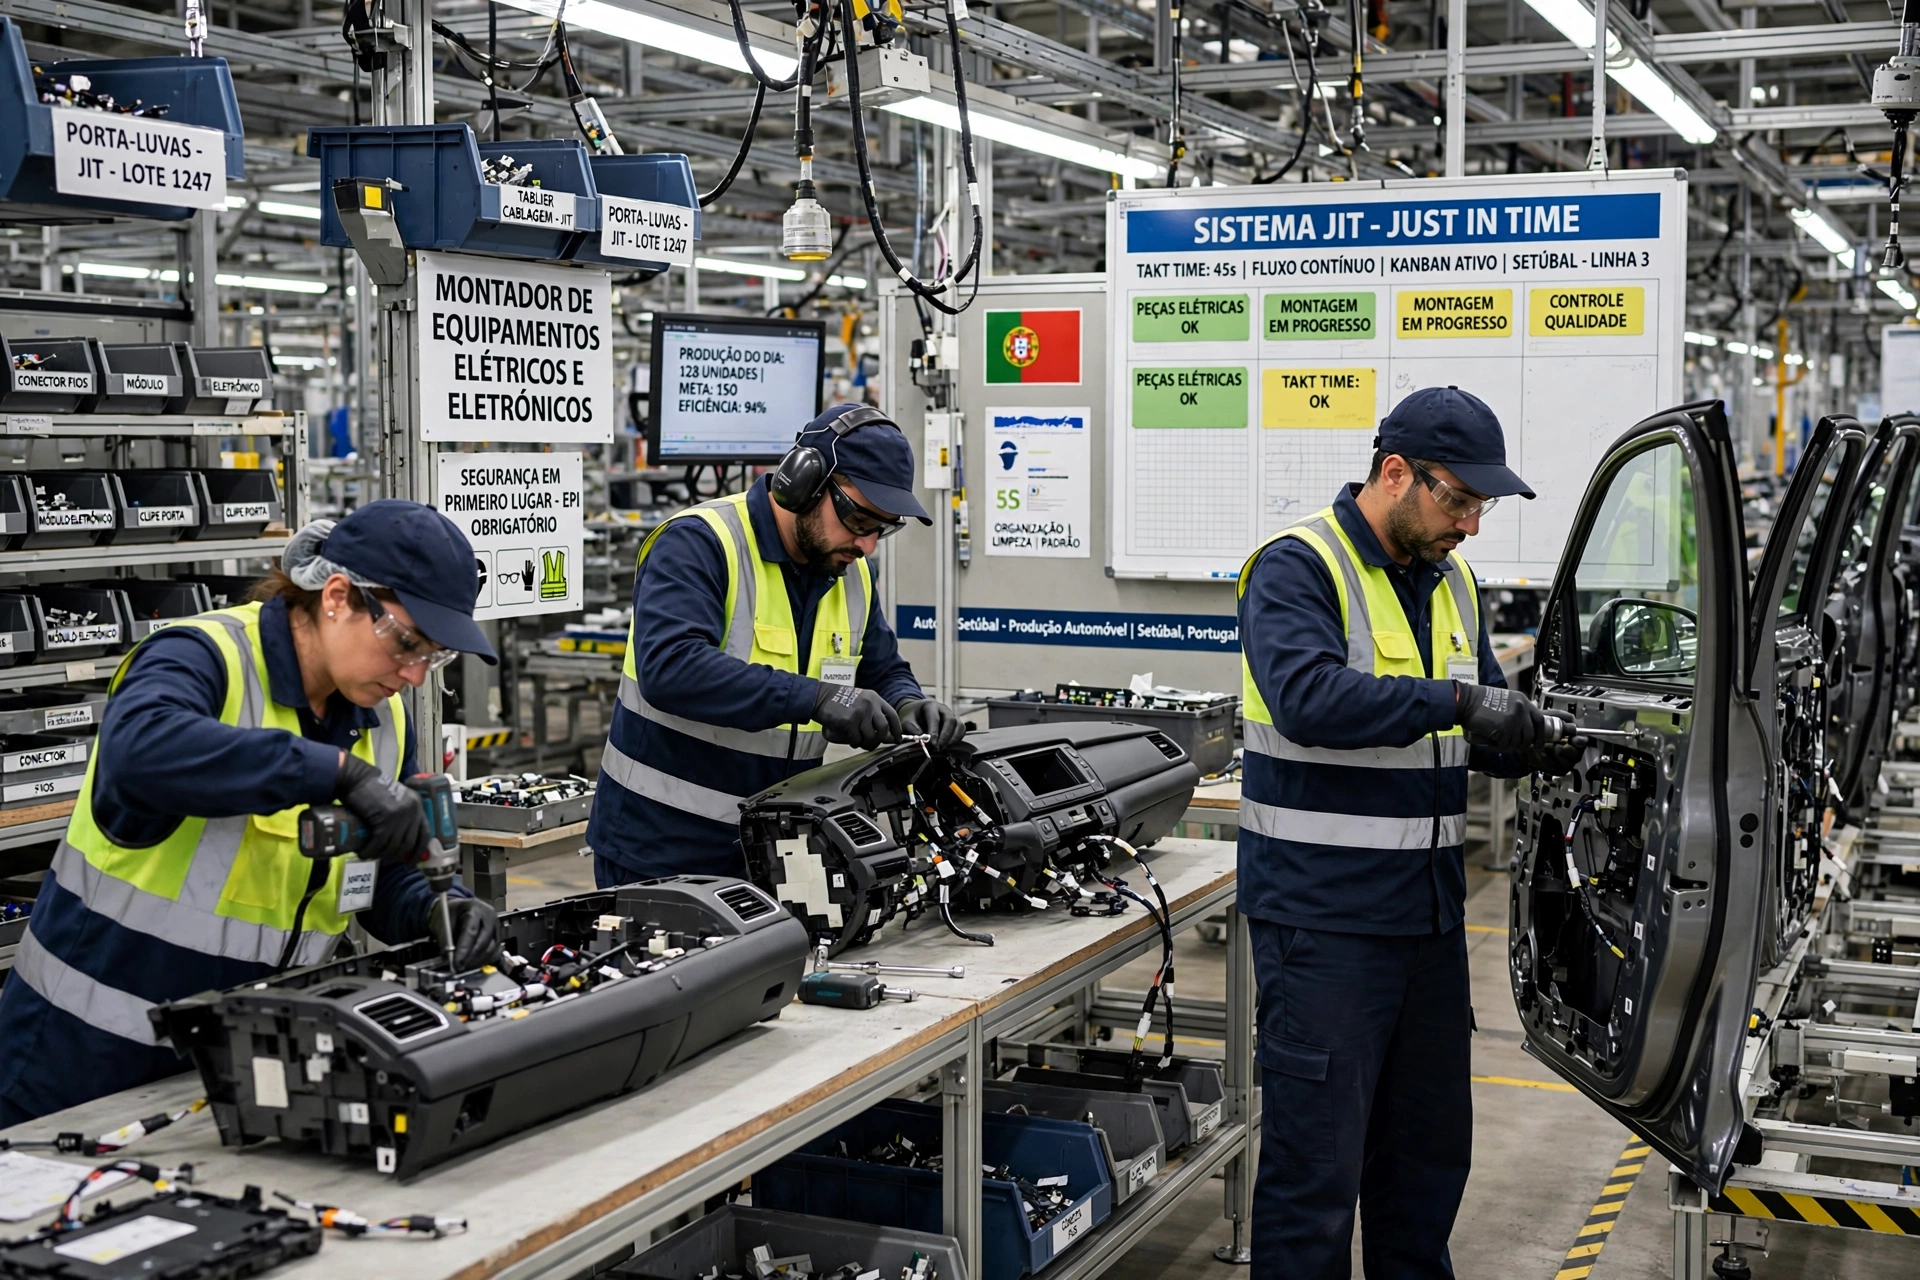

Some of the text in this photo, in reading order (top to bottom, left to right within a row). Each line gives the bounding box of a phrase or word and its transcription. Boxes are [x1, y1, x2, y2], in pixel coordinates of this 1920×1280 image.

[67, 122, 191, 158] PORTA-LUVAS
[78, 157, 104, 179] JIT
[123, 162, 166, 187] LOTE
[172, 169, 212, 191] 1247
[518, 190, 554, 208] TABLIER
[503, 205, 553, 223] CABLAGEM
[561, 214, 573, 226] JIT
[609, 206, 681, 231] PORTA-LUVAS
[1194, 212, 1317, 244] SISTEMA
[1322, 211, 1364, 240] JIT
[1386, 209, 1459, 239] JUST
[1467, 207, 1498, 236] IN
[1504, 205, 1580, 235] TIME
[611, 230, 626, 246] JIT
[636, 233, 660, 250] LOTE
[663, 237, 687, 254] 1247
[1136, 263, 1170, 279] TAKT
[1173, 262, 1210, 278] TIME:
[1213, 262, 1237, 277] 45s
[1252, 260, 1297, 276] FLUXO
[1300, 255, 1376, 275] CONTÍNUO
[1391, 256, 1451, 272] KANBAN
[1454, 255, 1498, 271] ATIVO
[1512, 250, 1578, 270] SETÚBAL
[1591, 251, 1637, 268] LINHA
[1641, 251, 1650, 267] 3
[436, 273, 593, 314] MONTADOR DE
[1549, 293, 1624, 309] CONTROLE
[1137, 298, 1244, 319] PEÇAS ELÉTRICAS
[1280, 298, 1358, 314] MONTAGEM
[1414, 296, 1494, 312] MONTAGEM
[1181, 320, 1199, 334] OK
[1269, 317, 1371, 333] EM PROGRESSO
[1402, 315, 1508, 331] EM PROGRESSO
[1544, 313, 1628, 331] QUALIDADE
[433, 312, 600, 351] EQUIPAMENTOS
[679, 346, 785, 364] PRODUÇÃO DO DIA:
[455, 349, 584, 386] ELÉTRICOS E
[702, 365, 758, 380] UNIDADES
[18, 374, 89, 389] CONECTOR FIOS
[126, 374, 164, 390] MÓDULO
[678, 382, 738, 396] META: 150
[1137, 370, 1242, 390] PEÇAS ELÉTRICAS
[1281, 374, 1360, 389] TAKT TIME:
[448, 388, 593, 423] ELETRÓNICOS
[744, 401, 767, 414] 94%
[1180, 392, 1198, 406] OK
[1309, 394, 1330, 409] OK
[461, 468, 561, 490] SEGURANÇA EM
[445, 493, 508, 512] PRIMEIRO
[511, 492, 552, 510] LUGAR
[562, 491, 580, 508] EPI
[996, 489, 1021, 510] 5S
[471, 512, 557, 536] OBRIGATÓRIO
[994, 521, 1064, 537] ORGANIZAÇÃO
[992, 536, 1032, 548] LIMPEZA
[1041, 535, 1080, 548] PADRÃO
[957, 615, 999, 632] Setúbal
[1008, 619, 1062, 637] Produção
[1063, 620, 1128, 637] Automóvel
[1137, 621, 1185, 641] Setúbal,
[1187, 625, 1239, 644] Portugal
